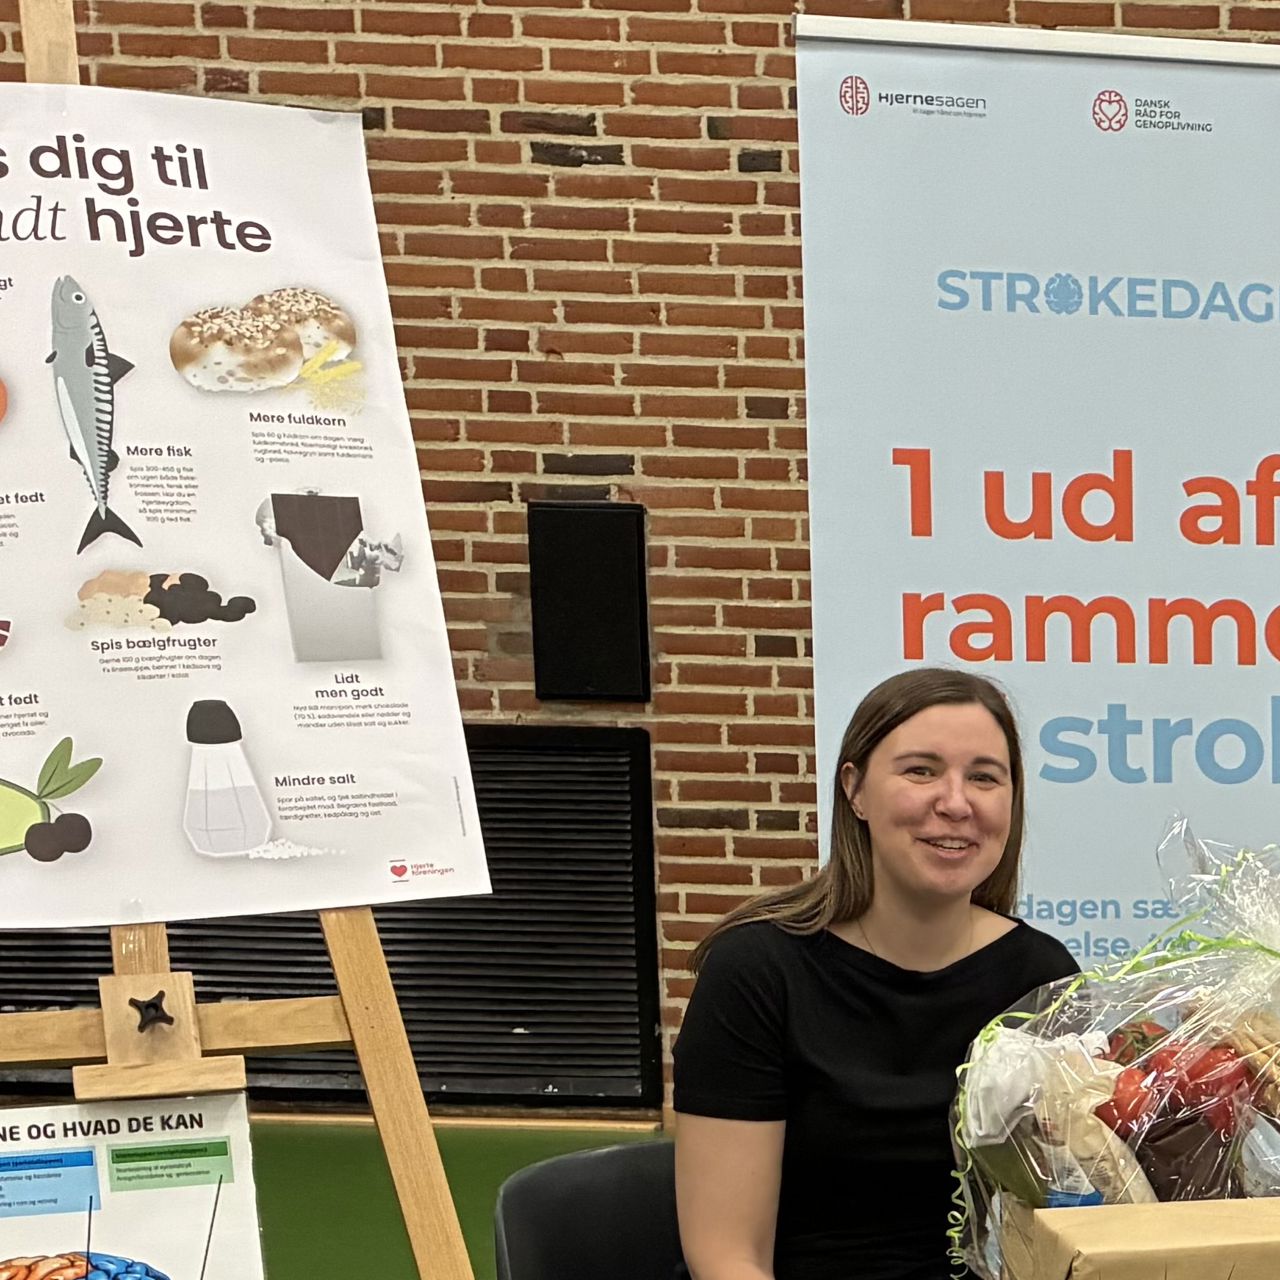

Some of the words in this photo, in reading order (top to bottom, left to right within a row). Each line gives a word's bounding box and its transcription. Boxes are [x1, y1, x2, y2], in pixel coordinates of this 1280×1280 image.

[1135, 98, 1170, 108] DANSK
[1135, 108, 1157, 118] RÅD
[1160, 111, 1181, 119] FOR
[1135, 120, 1212, 132] GENOPLIVNING
[29, 134, 132, 196] dig
[151, 142, 209, 190] til
[85, 198, 272, 257] hjerte
[249, 412, 285, 424] Mere
[288, 413, 346, 427] fuldkorn
[126, 446, 163, 456] Mere
[167, 445, 192, 457] fisk
[14, 491, 45, 504] fedt
[892, 447, 933, 537] 1
[983, 449, 1135, 542] ud
[91, 639, 122, 654] Spis
[126, 636, 218, 651] bælgfrugter
[334, 673, 360, 684] Lidt
[8, 693, 39, 706] fedt
[315, 689, 347, 699] men
[351, 687, 384, 700] godt
[274, 775, 325, 787] Mindre
[328, 773, 356, 784] salt
[27, 1123, 56, 1140] OG
[63, 1119, 120, 1138] HVAD
[128, 1116, 154, 1133] DE
[160, 1113, 204, 1131] KAN
